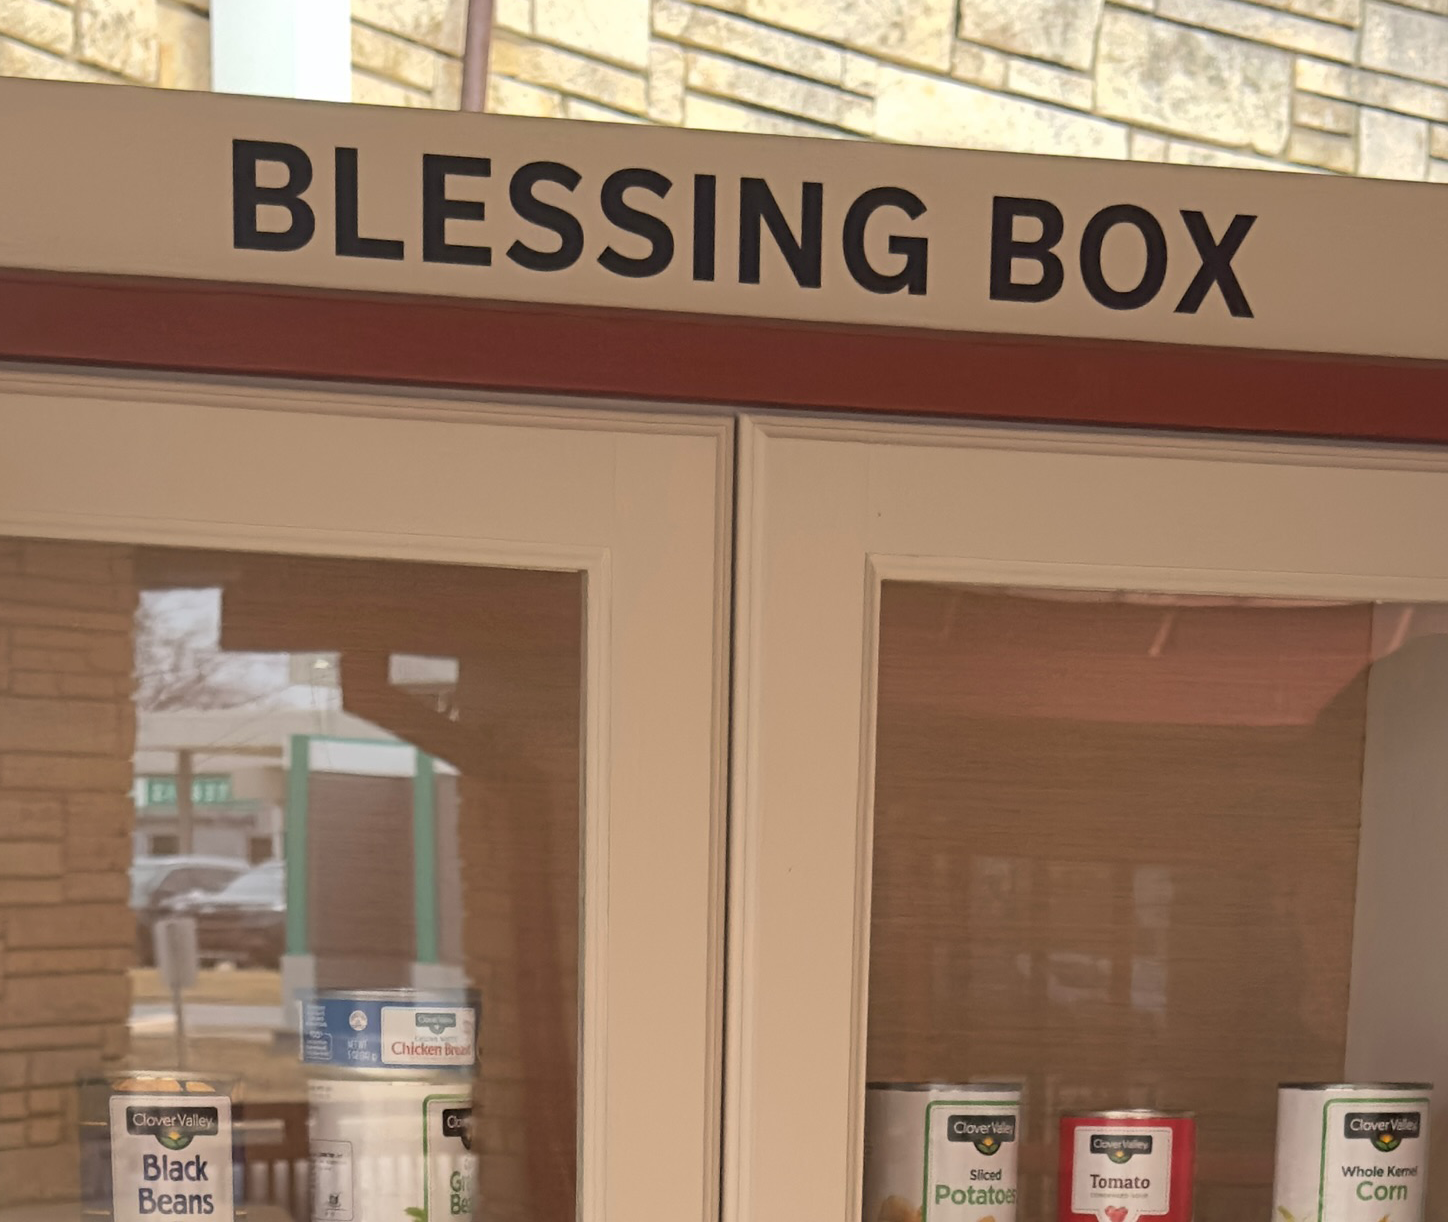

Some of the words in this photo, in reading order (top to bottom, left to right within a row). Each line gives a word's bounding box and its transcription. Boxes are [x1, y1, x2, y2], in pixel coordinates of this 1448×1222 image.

[231, 137, 929, 296] BLESSING
[987, 194, 1258, 319] BOX
[391, 1041, 442, 1056] Chicken
[133, 1112, 176, 1127] Clover
[177, 1113, 213, 1129] Valley
[1349, 1118, 1389, 1131] Clover
[1390, 1118, 1418, 1132] Valley
[953, 1121, 990, 1134] Clover
[991, 1121, 1015, 1136] Valley
[1093, 1138, 1122, 1149] Clover
[1122, 1139, 1149, 1150] Valley
[143, 1154, 209, 1182] Black
[970, 1169, 1002, 1181] Sliced
[1341, 1166, 1384, 1177] Whole
[1387, 1166, 1417, 1177] Kernel
[1090, 1174, 1151, 1189] Tomato
[935, 1184, 1016, 1205] Potatoes
[1356, 1181, 1408, 1201] Corn
[138, 1188, 214, 1215] Beans
